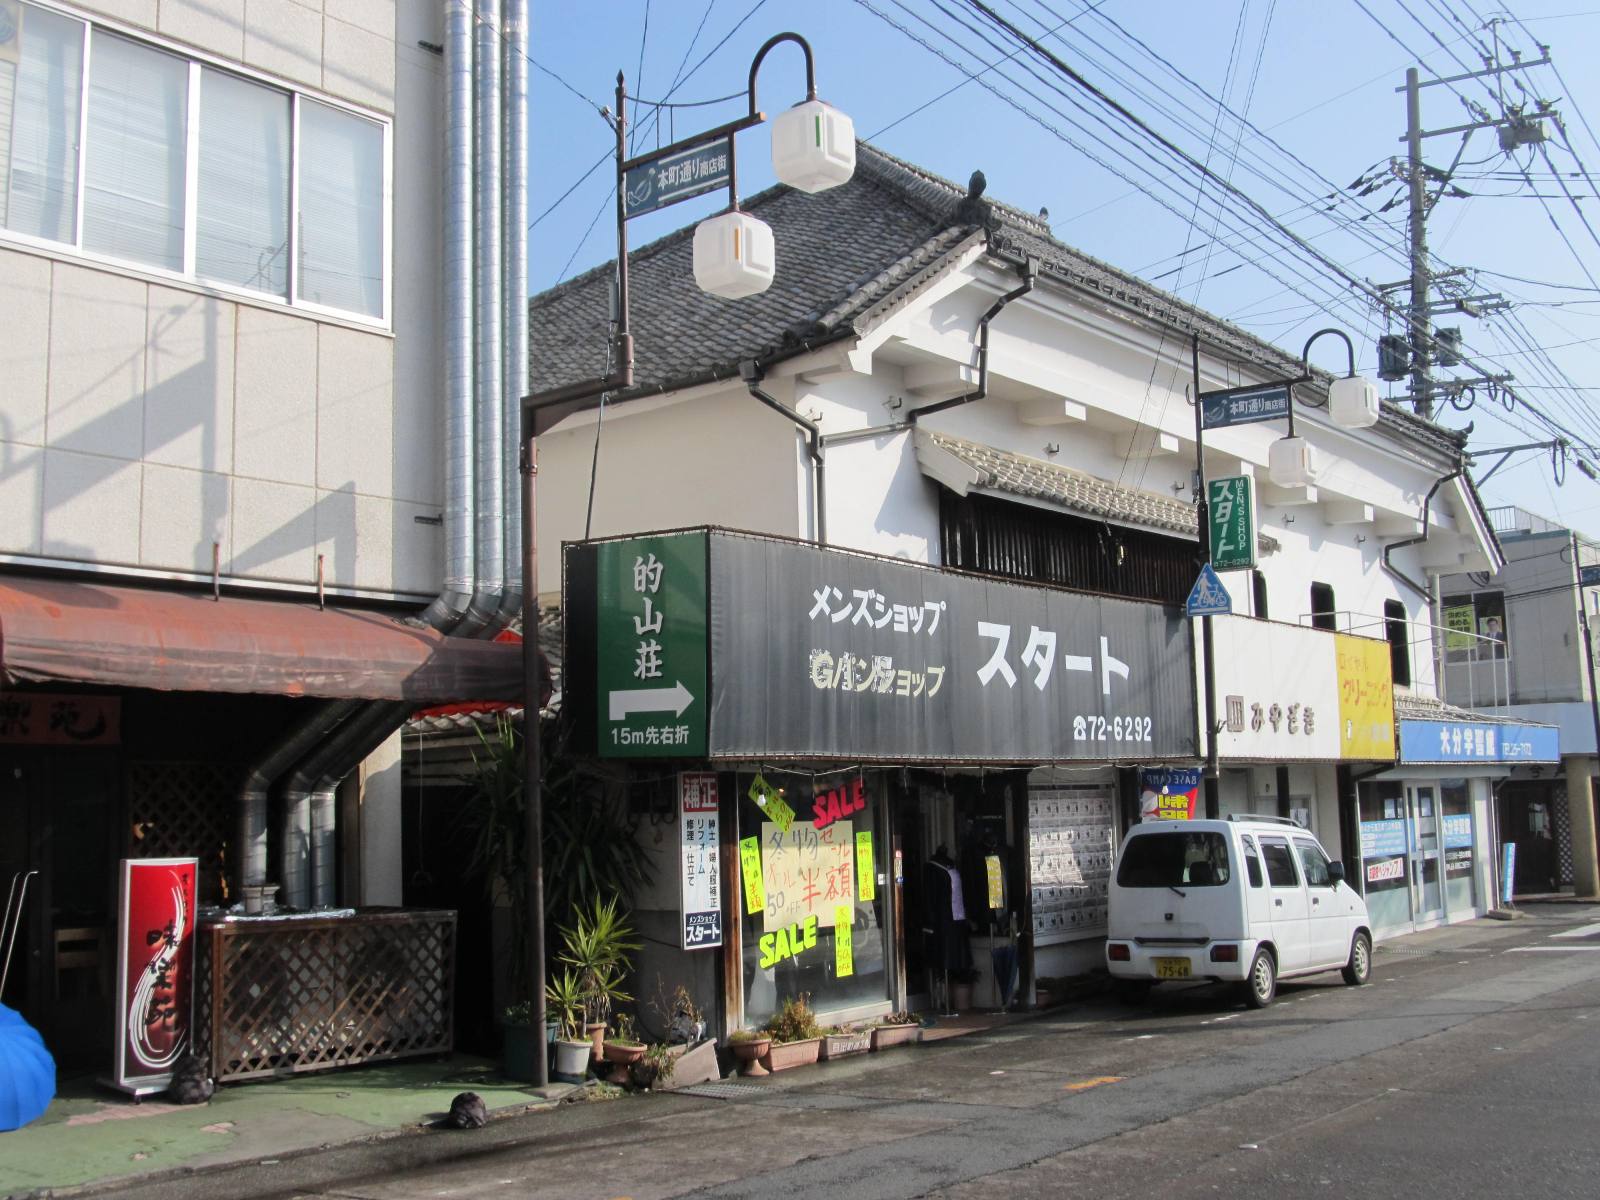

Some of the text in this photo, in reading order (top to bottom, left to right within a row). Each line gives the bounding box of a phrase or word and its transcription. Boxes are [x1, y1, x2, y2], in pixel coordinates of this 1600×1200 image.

[658, 155, 727, 190] 本町通り商店街
[1213, 480, 1235, 560] スタート
[633, 552, 664, 681] 的山荘
[808, 584, 947, 637] メンズショップ
[976, 621, 1130, 695] スタート
[611, 726, 689, 745] 15m先右折
[1088, 715, 1152, 742] 72-6292
[1250, 702, 1315, 736] みやざき
[684, 777, 718, 810] 補正
[812, 778, 866, 830] SALE
[769, 827, 818, 861] 冬物
[801, 862, 851, 913] 半額
[686, 923, 720, 943] スタート
[759, 914, 818, 969] SALE
